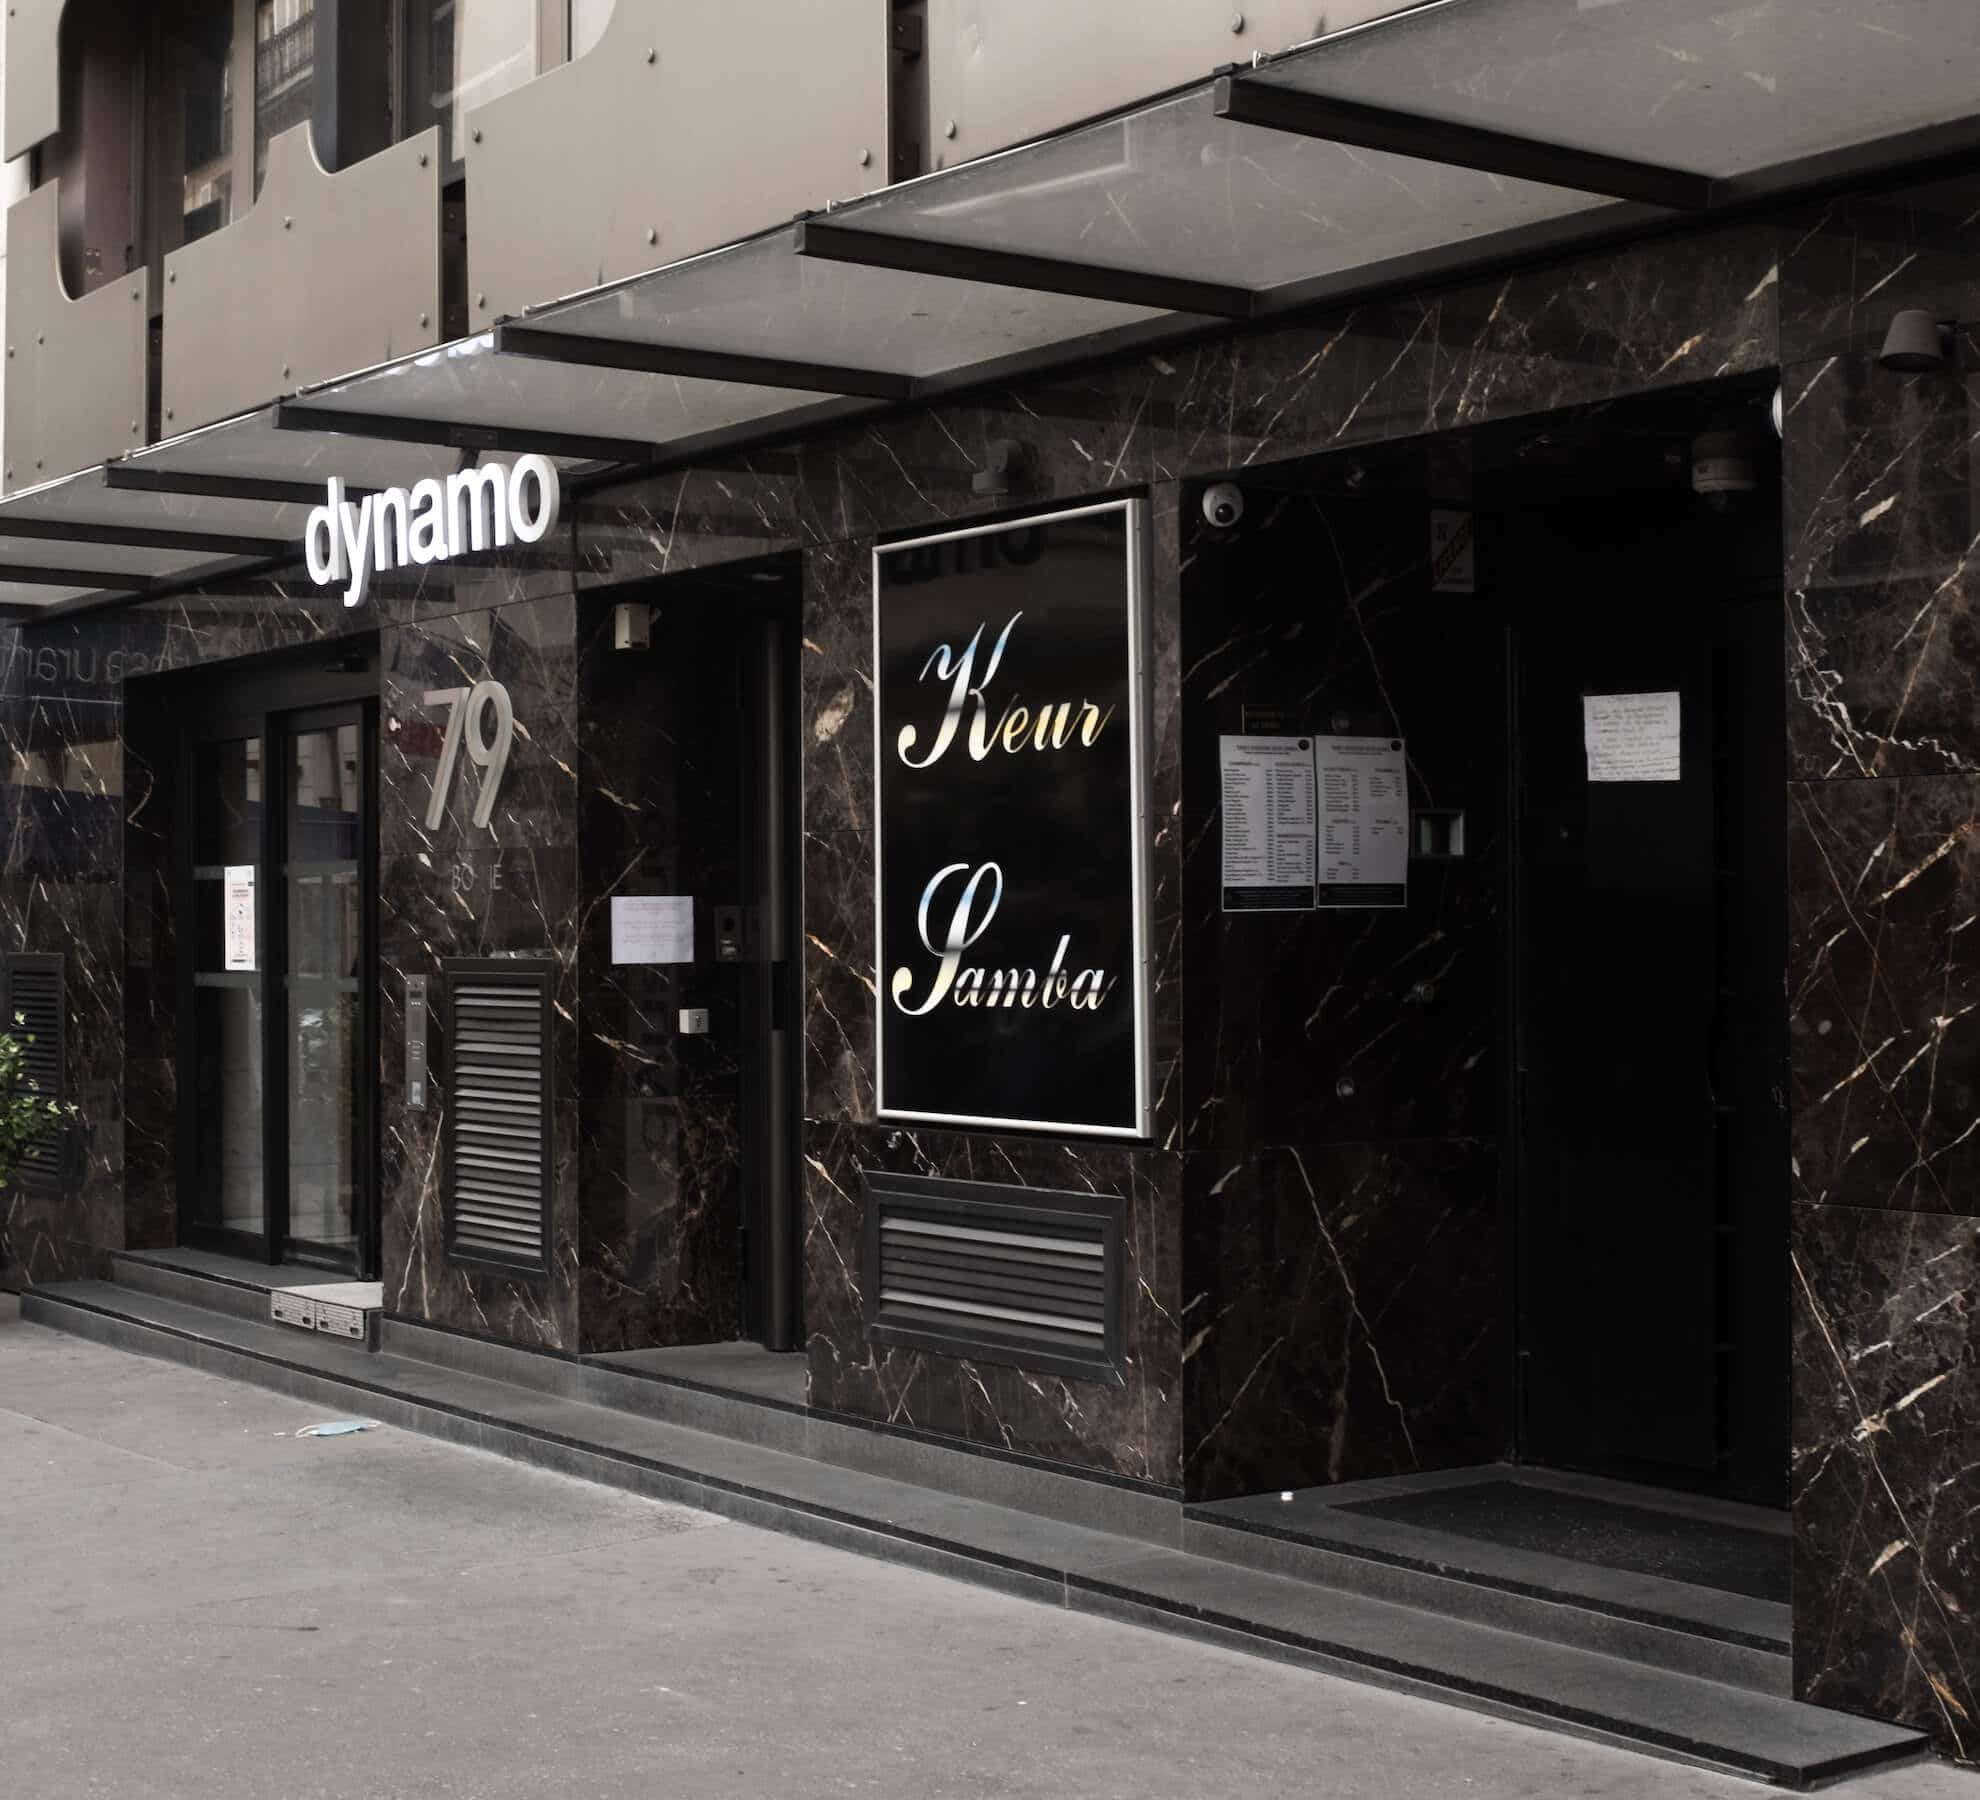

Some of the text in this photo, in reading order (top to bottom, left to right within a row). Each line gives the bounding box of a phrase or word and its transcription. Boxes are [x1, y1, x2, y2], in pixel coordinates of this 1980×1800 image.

[305, 453, 559, 608] dynamo
[424, 680, 513, 831] 79
[897, 610, 1116, 769] Keur
[891, 862, 1117, 1016] Samba
